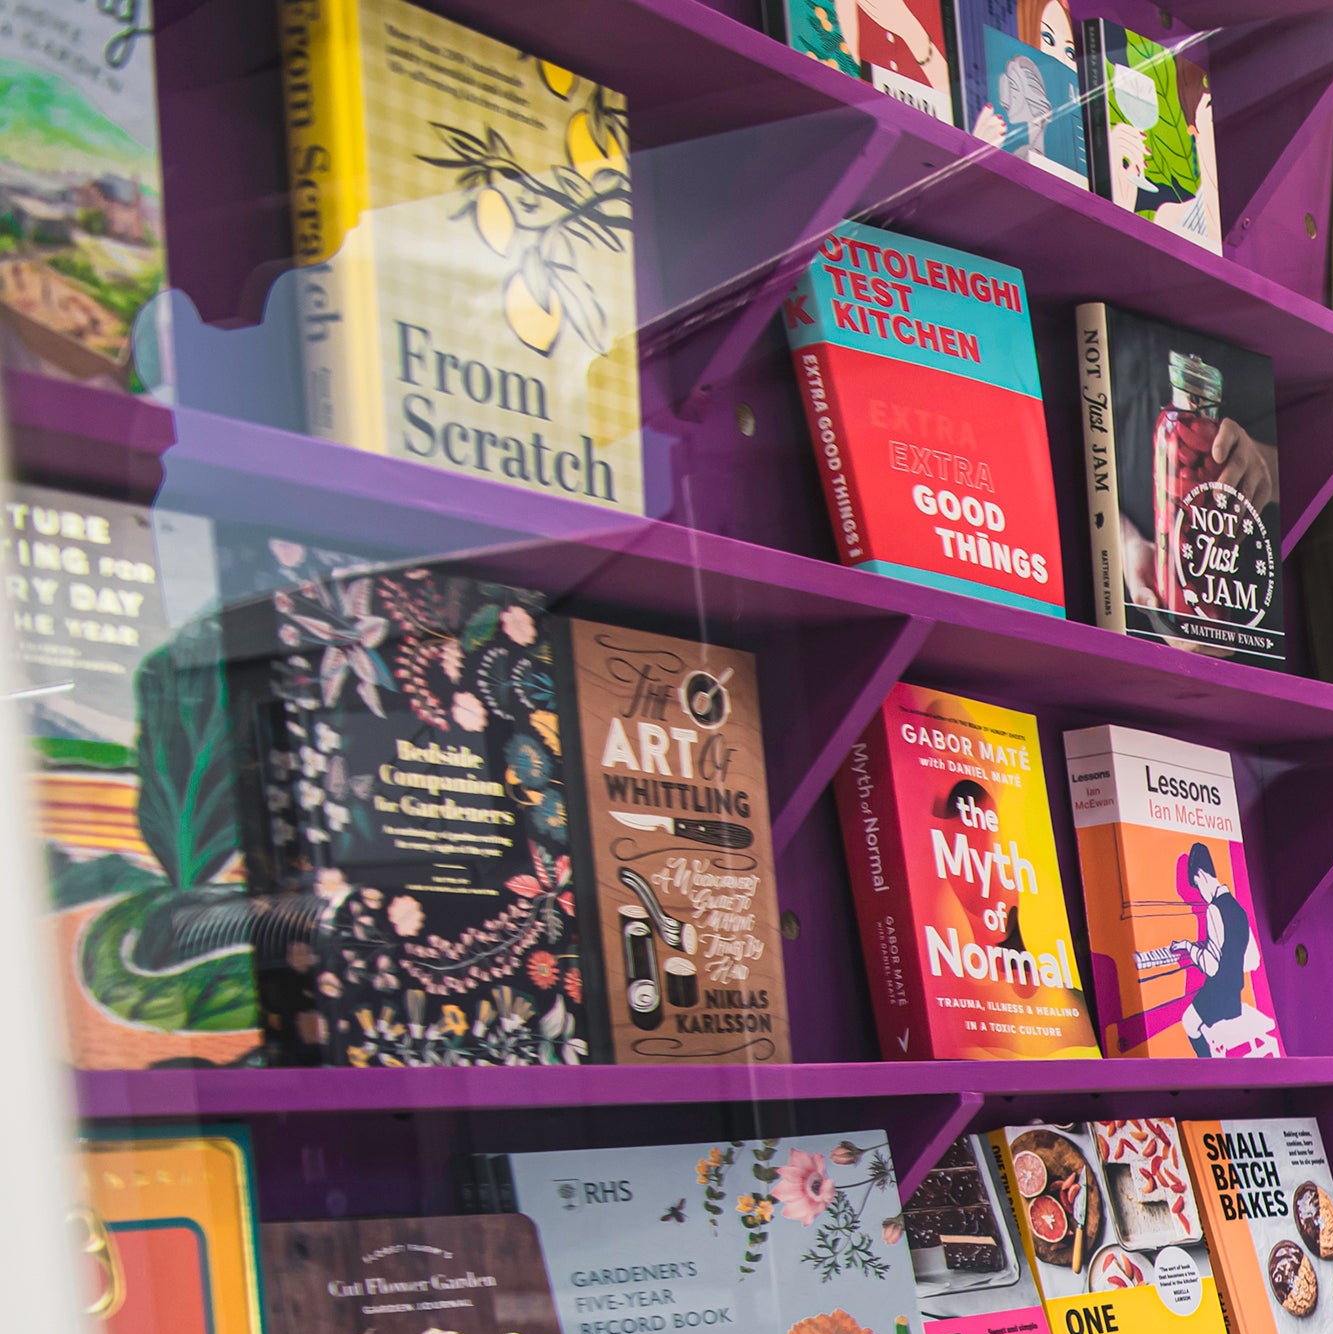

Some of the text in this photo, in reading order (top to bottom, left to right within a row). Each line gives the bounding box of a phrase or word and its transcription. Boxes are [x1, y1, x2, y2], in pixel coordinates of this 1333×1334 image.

[817, 233, 1024, 313] OTTOLENGHI
[824, 265, 913, 313] TEST
[831, 298, 981, 364] KITCHEN
[396, 320, 552, 421] From
[802, 353, 839, 472] EXTRA GOOD
[1083, 328, 1110, 493] NOT JAM
[403, 394, 618, 502] Scratch
[888, 440, 995, 493] EXTRA
[912, 485, 1006, 532] GOOD
[1190, 504, 1238, 538] NOT
[1188, 533, 1240, 577] Just
[69, 581, 145, 619] DAY
[1202, 573, 1259, 613] JAM
[64, 617, 141, 647] YEAR
[1190, 622, 1266, 650] MATTHEW EVANS
[396, 739, 485, 770] Bedside
[601, 717, 698, 779] ART
[901, 723, 1032, 772] GABOR MATÉ
[379, 763, 506, 797] Companion
[919, 756, 1022, 788] with DANIEL MATÉ
[1071, 770, 1111, 783] Lessons
[1145, 765, 1222, 805] Lessons
[400, 795, 516, 826] Gardeners
[604, 773, 751, 820] WHITTLING
[1075, 797, 1114, 811] McEwan
[851, 742, 890, 893] Myth Normal
[956, 795, 1000, 833] the
[1149, 798, 1233, 832] Ian McEwan
[930, 828, 1038, 899] Myth
[983, 901, 1008, 934] of
[923, 925, 1075, 990] Normal
[705, 989, 770, 1010] NIKLAS
[936, 996, 1080, 1019] TRAUMA, ILLNESS HEALING
[675, 1012, 773, 1034] KARLSSON
[989, 1023, 1063, 1038] TOXIC CULTURE
[1203, 1131, 1274, 1161] SMALL
[583, 1180, 634, 1204] RHS
[1211, 1161, 1281, 1191] BATCH
[1219, 1189, 1289, 1221] BAKES
[327, 1271, 498, 1297] Cut Flower Garden
[570, 1261, 699, 1288] GARDENER'S
[574, 1289, 677, 1313] FIVE-YEAR
[672, 1307, 733, 1329] BOOK
